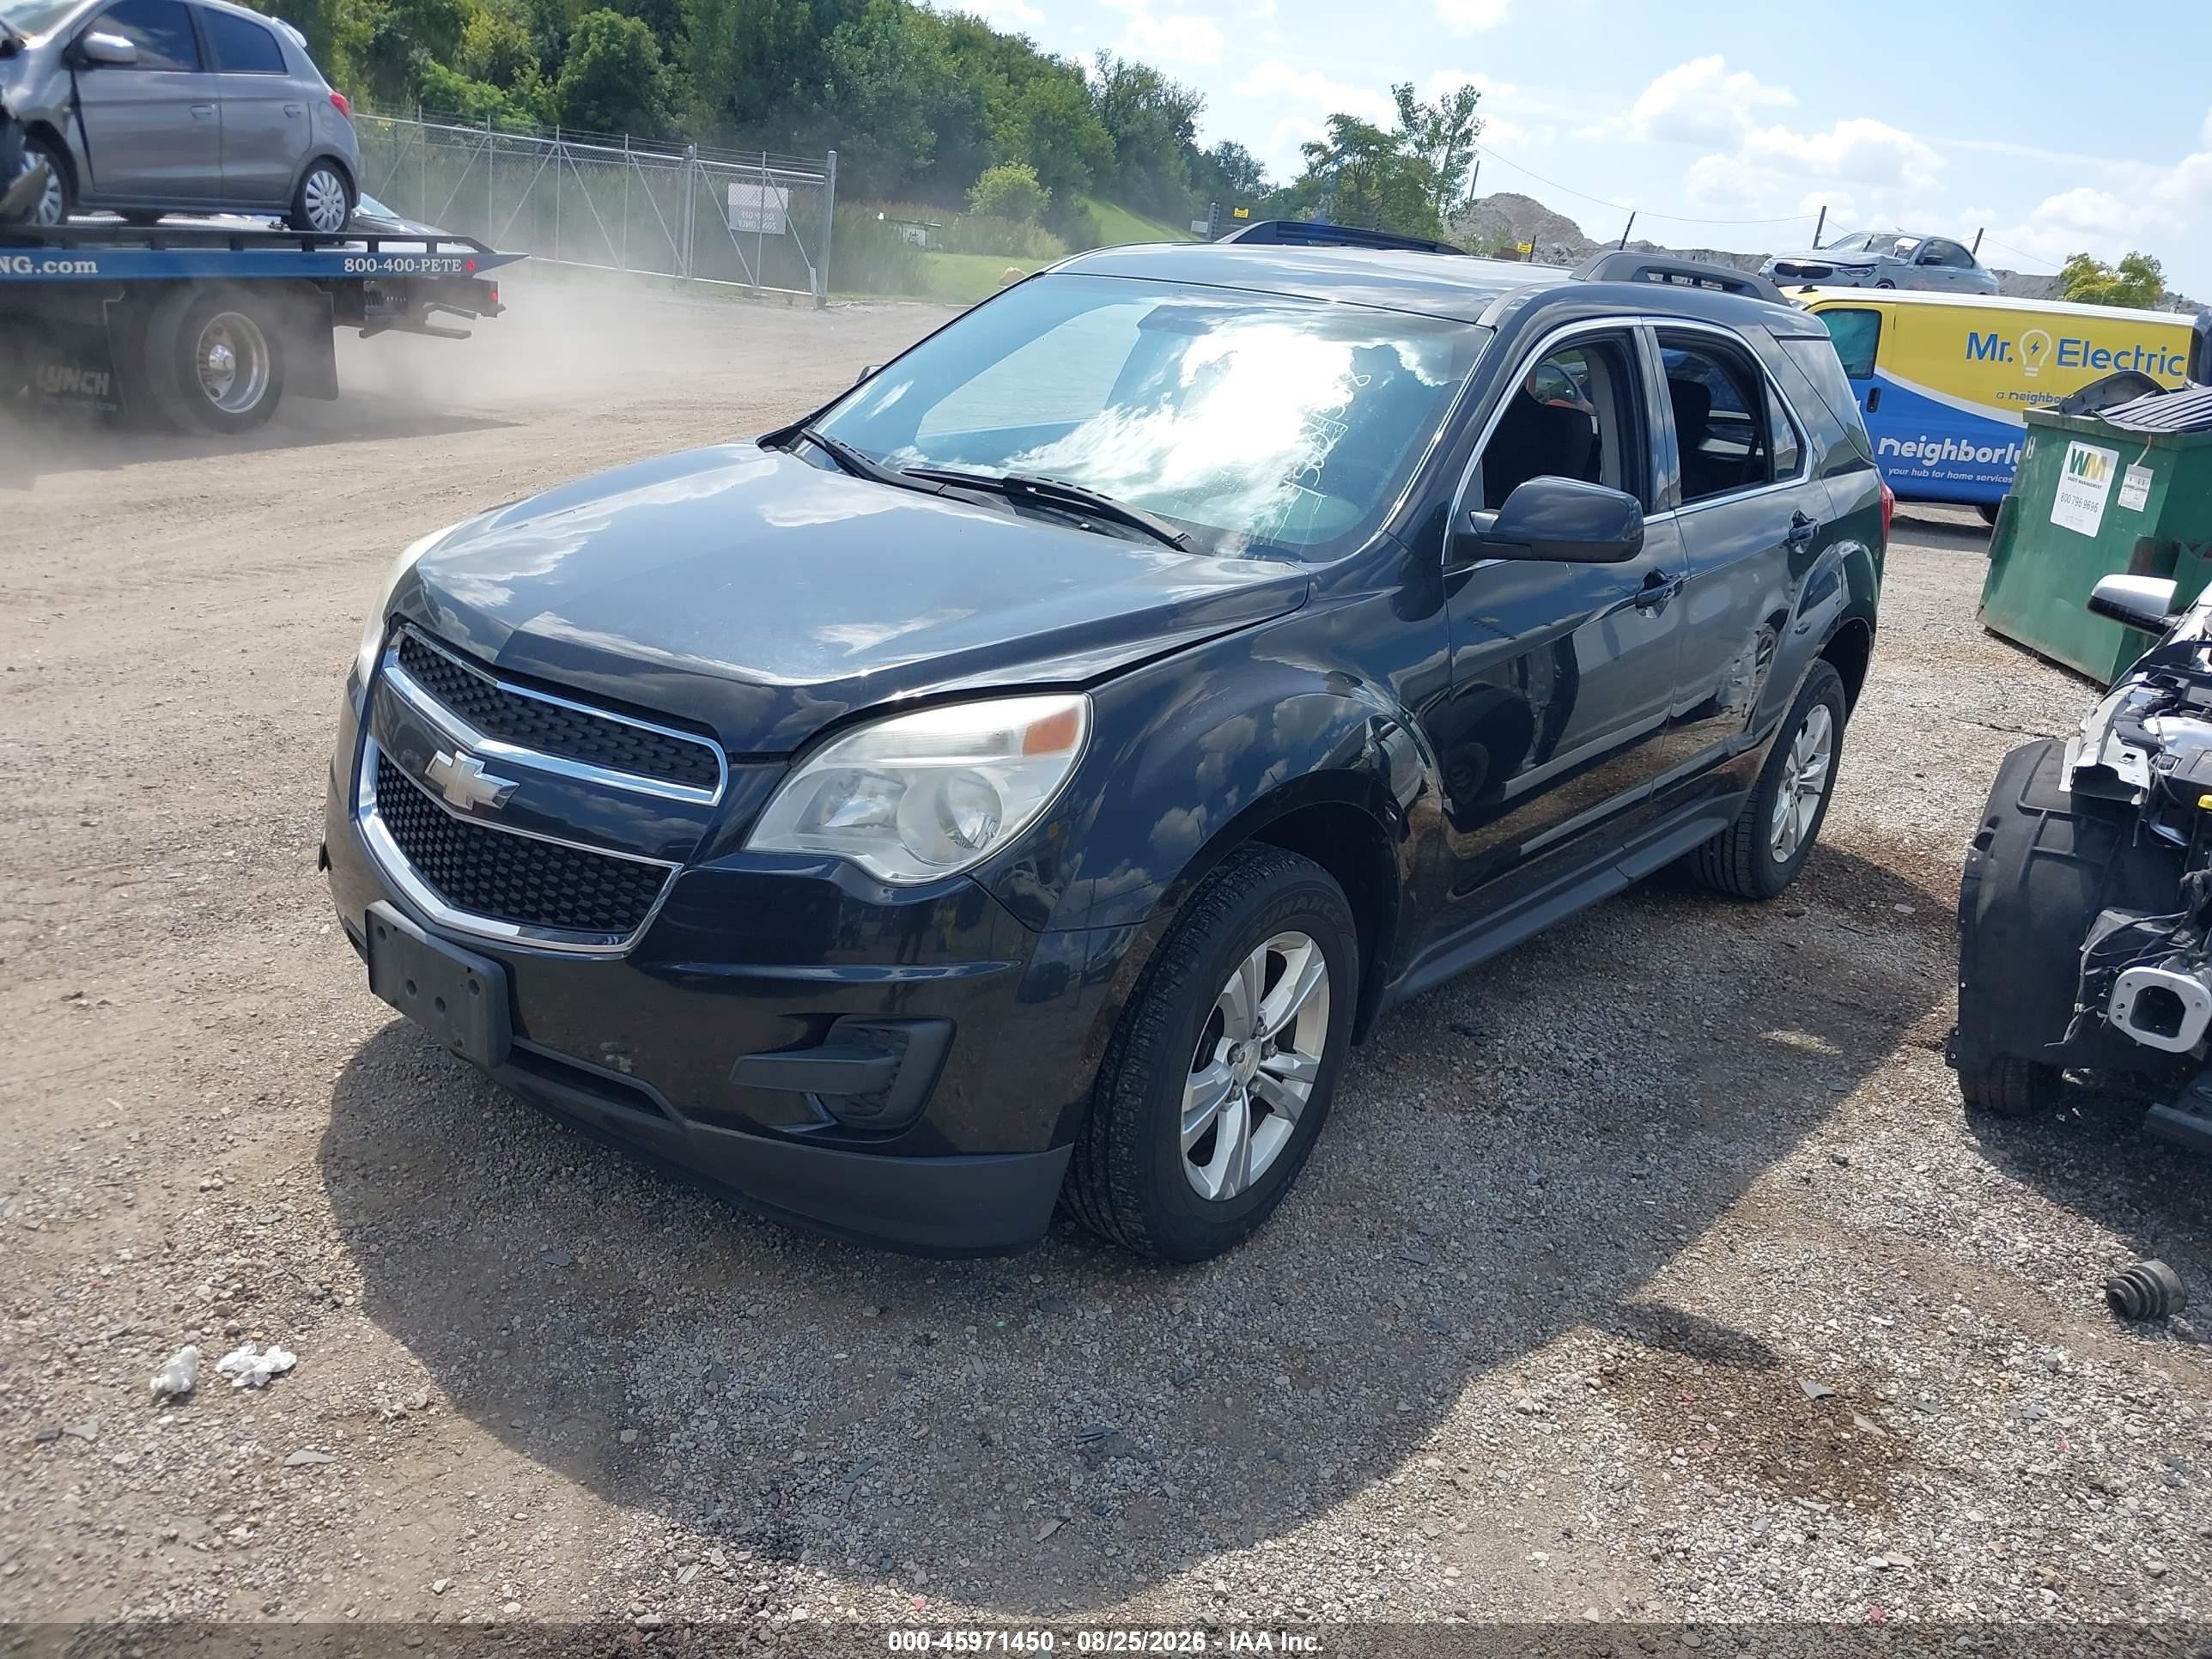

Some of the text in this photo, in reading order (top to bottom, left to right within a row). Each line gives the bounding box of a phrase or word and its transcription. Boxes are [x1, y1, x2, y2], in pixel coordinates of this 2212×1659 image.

[344, 258, 462, 273] 800-400-PETE
[1966, 331, 2185, 377] Mr. Electric
[36, 364, 110, 396] LYNCH
[1996, 391, 2004, 399] a
[2069, 448, 2107, 481] WM
[1888, 468, 2014, 483] your hub for home services
[2061, 492, 2100, 513] 800 796 9696
